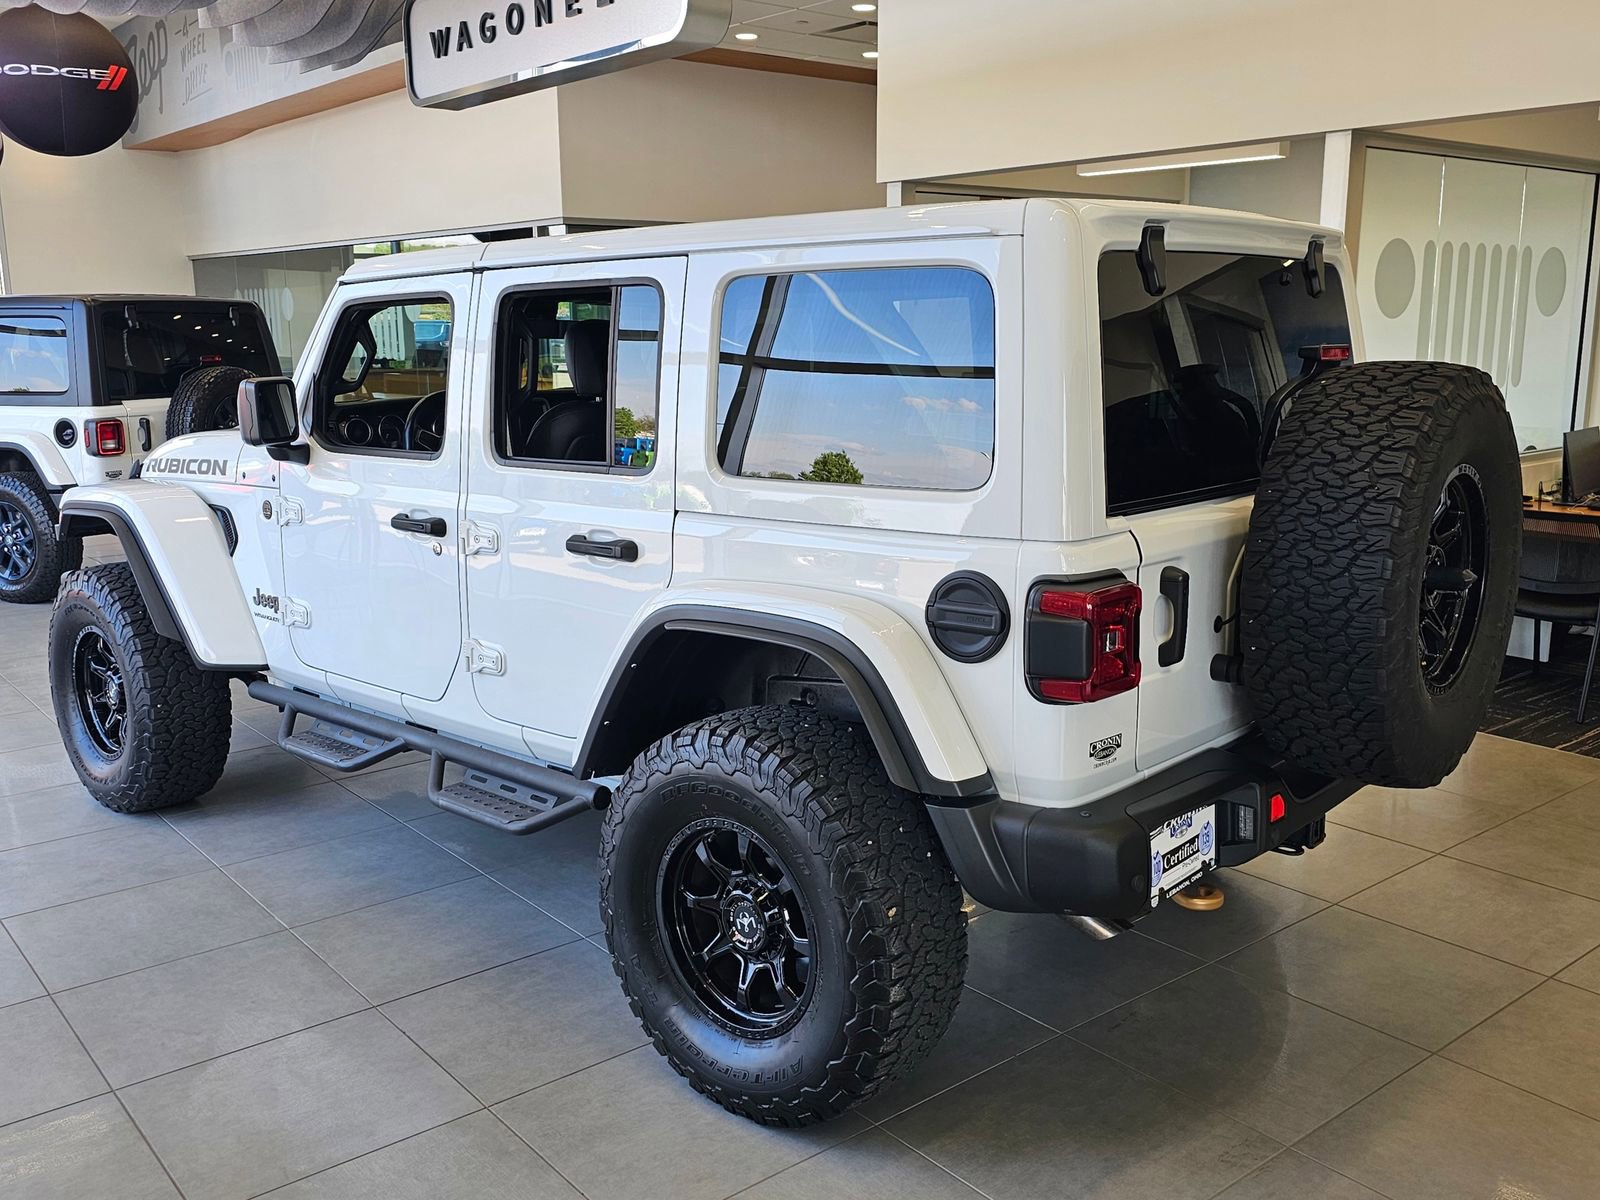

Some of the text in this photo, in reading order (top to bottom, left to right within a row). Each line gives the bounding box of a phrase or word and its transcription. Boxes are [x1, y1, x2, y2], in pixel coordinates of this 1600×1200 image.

[429, 0, 615, 59] WAGONE
[180, 32, 207, 72] WHEEL
[0, 63, 111, 81] ODGE
[185, 63, 208, 104] DRIVE
[146, 459, 228, 476] RUBICON
[253, 588, 280, 614] Jeep
[1090, 734, 1122, 754] CRONIN
[1164, 838, 1198, 869] Certified
